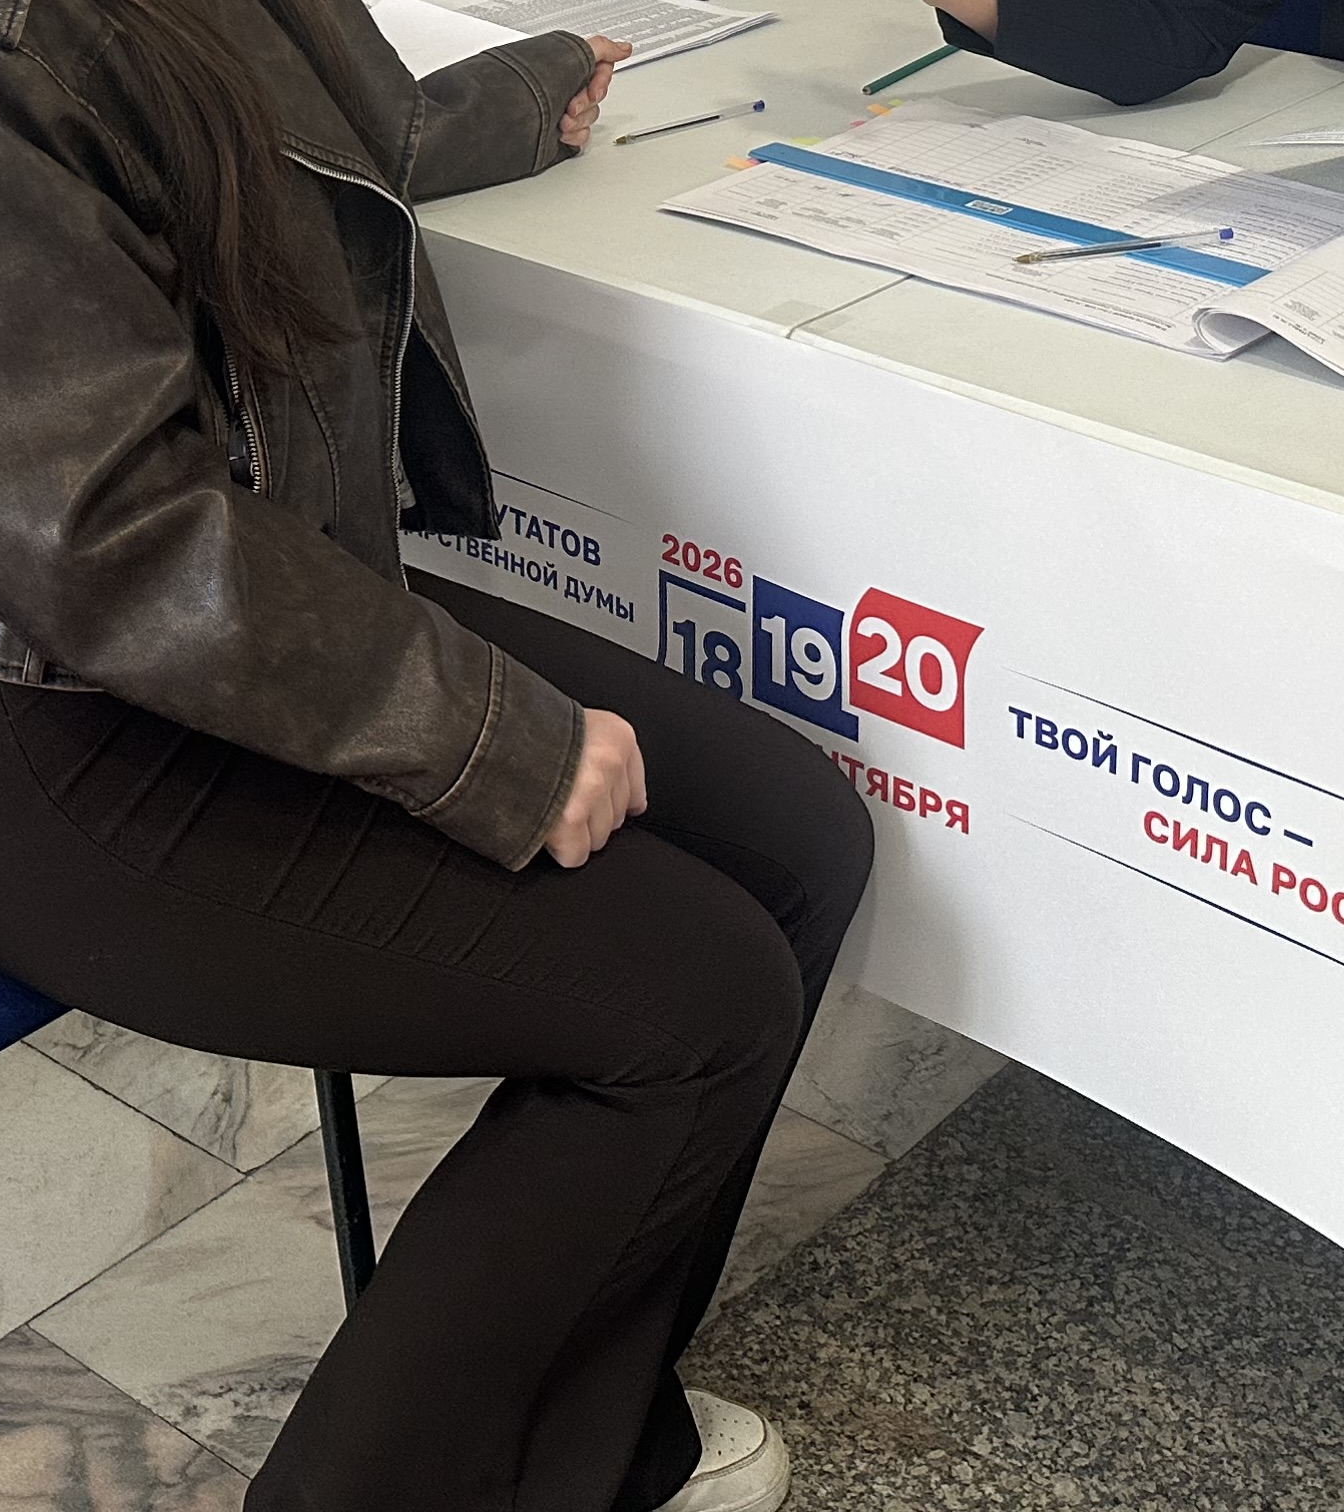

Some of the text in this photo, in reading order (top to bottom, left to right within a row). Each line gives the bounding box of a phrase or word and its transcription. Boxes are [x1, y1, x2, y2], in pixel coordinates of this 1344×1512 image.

[403, 529, 635, 623] СТВЕННОЙ ДУМЫ
[497, 504, 602, 567] УТАТОВ
[661, 533, 744, 589] 2026
[672, 615, 958, 713] 18 19 20
[818, 744, 970, 835] ТЯБРЯ
[1008, 705, 1118, 775] ТВОЙ
[1130, 752, 1272, 837] ГОЛОС
[1143, 810, 1258, 886] СИЛА
